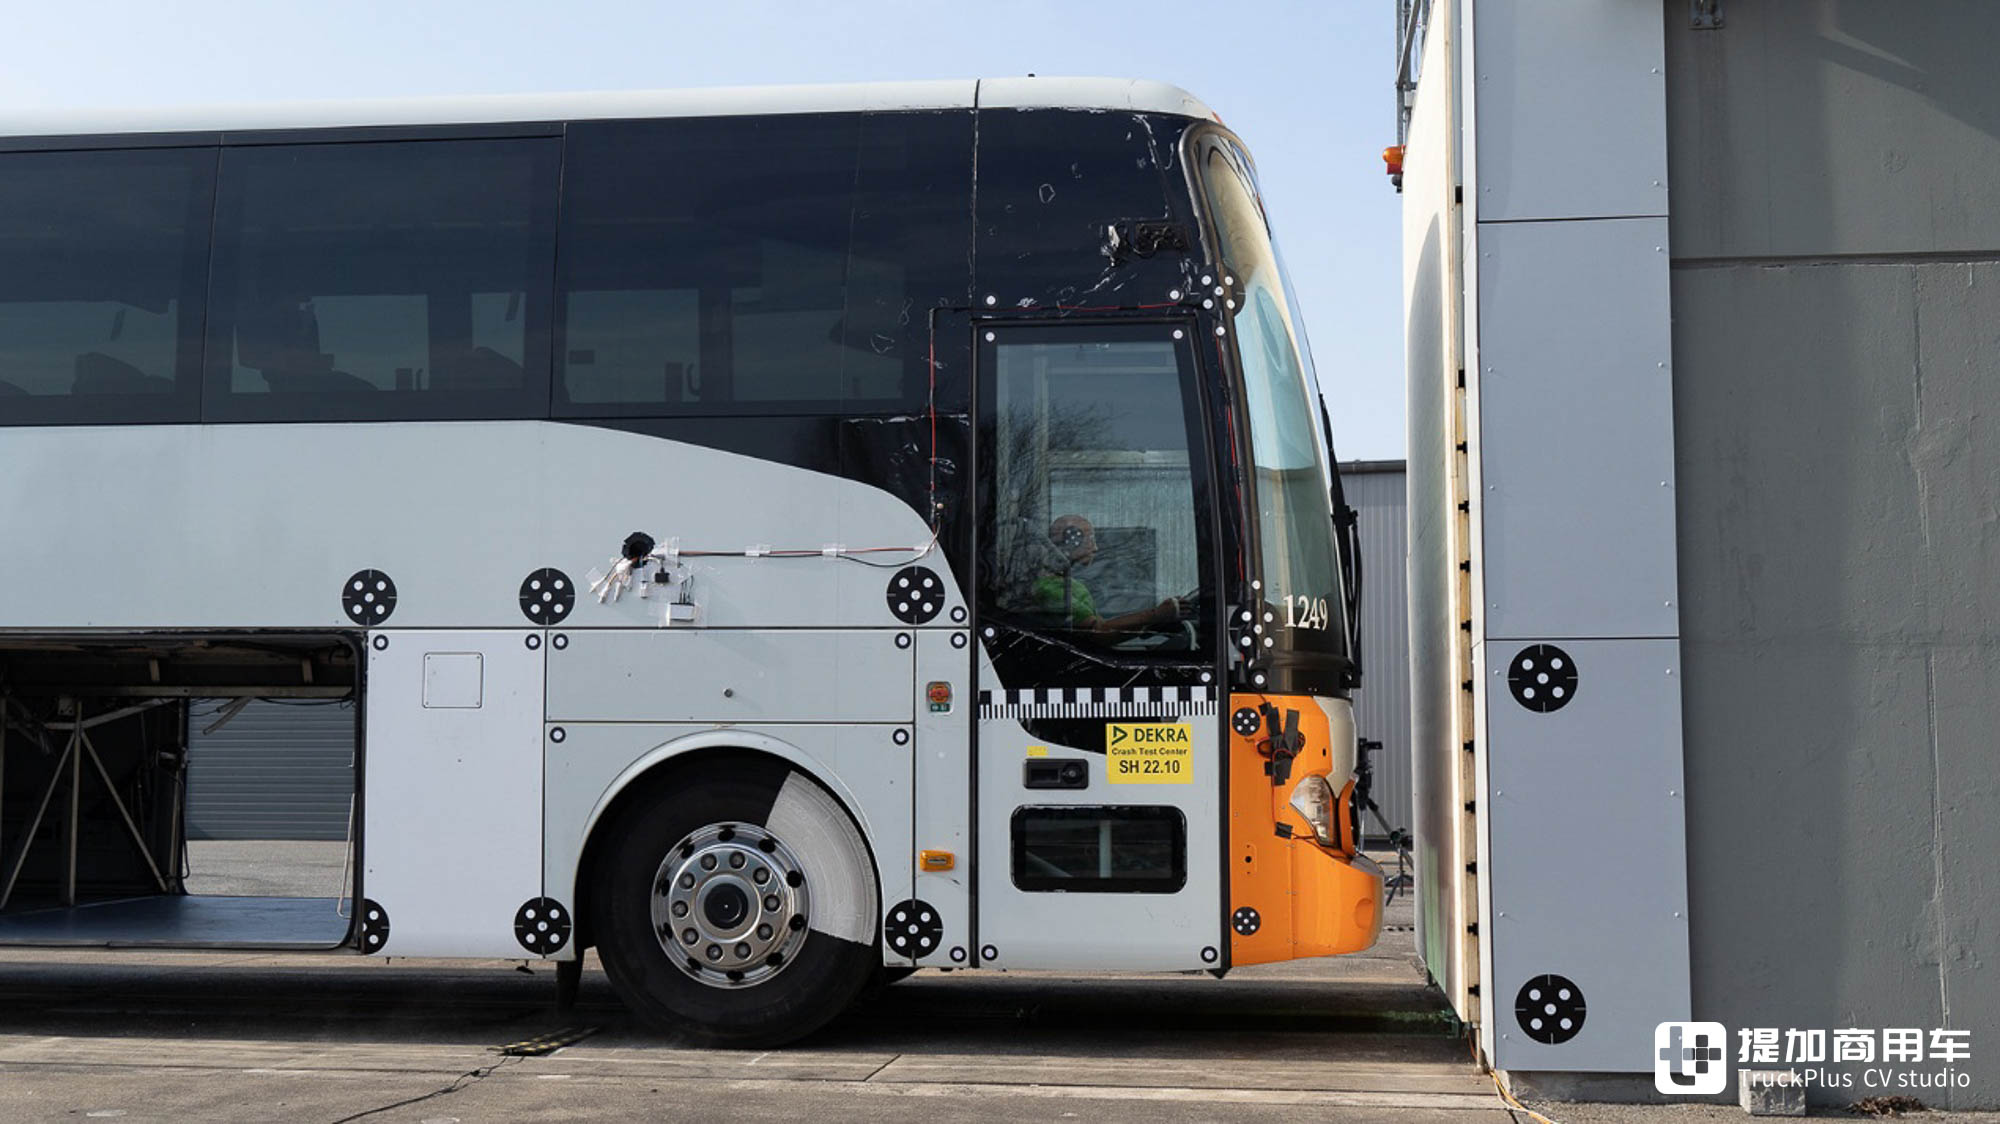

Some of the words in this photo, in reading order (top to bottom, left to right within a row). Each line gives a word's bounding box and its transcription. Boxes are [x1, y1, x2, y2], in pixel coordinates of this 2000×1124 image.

[1283, 594, 1328, 631] 1249
[1134, 728, 1188, 742] DEKRA
[1111, 747, 1137, 755] Crash
[1139, 747, 1157, 755] Test
[1160, 747, 1187, 755] Center
[1119, 760, 1139, 773] SH
[1144, 760, 1180, 773] 22.10
